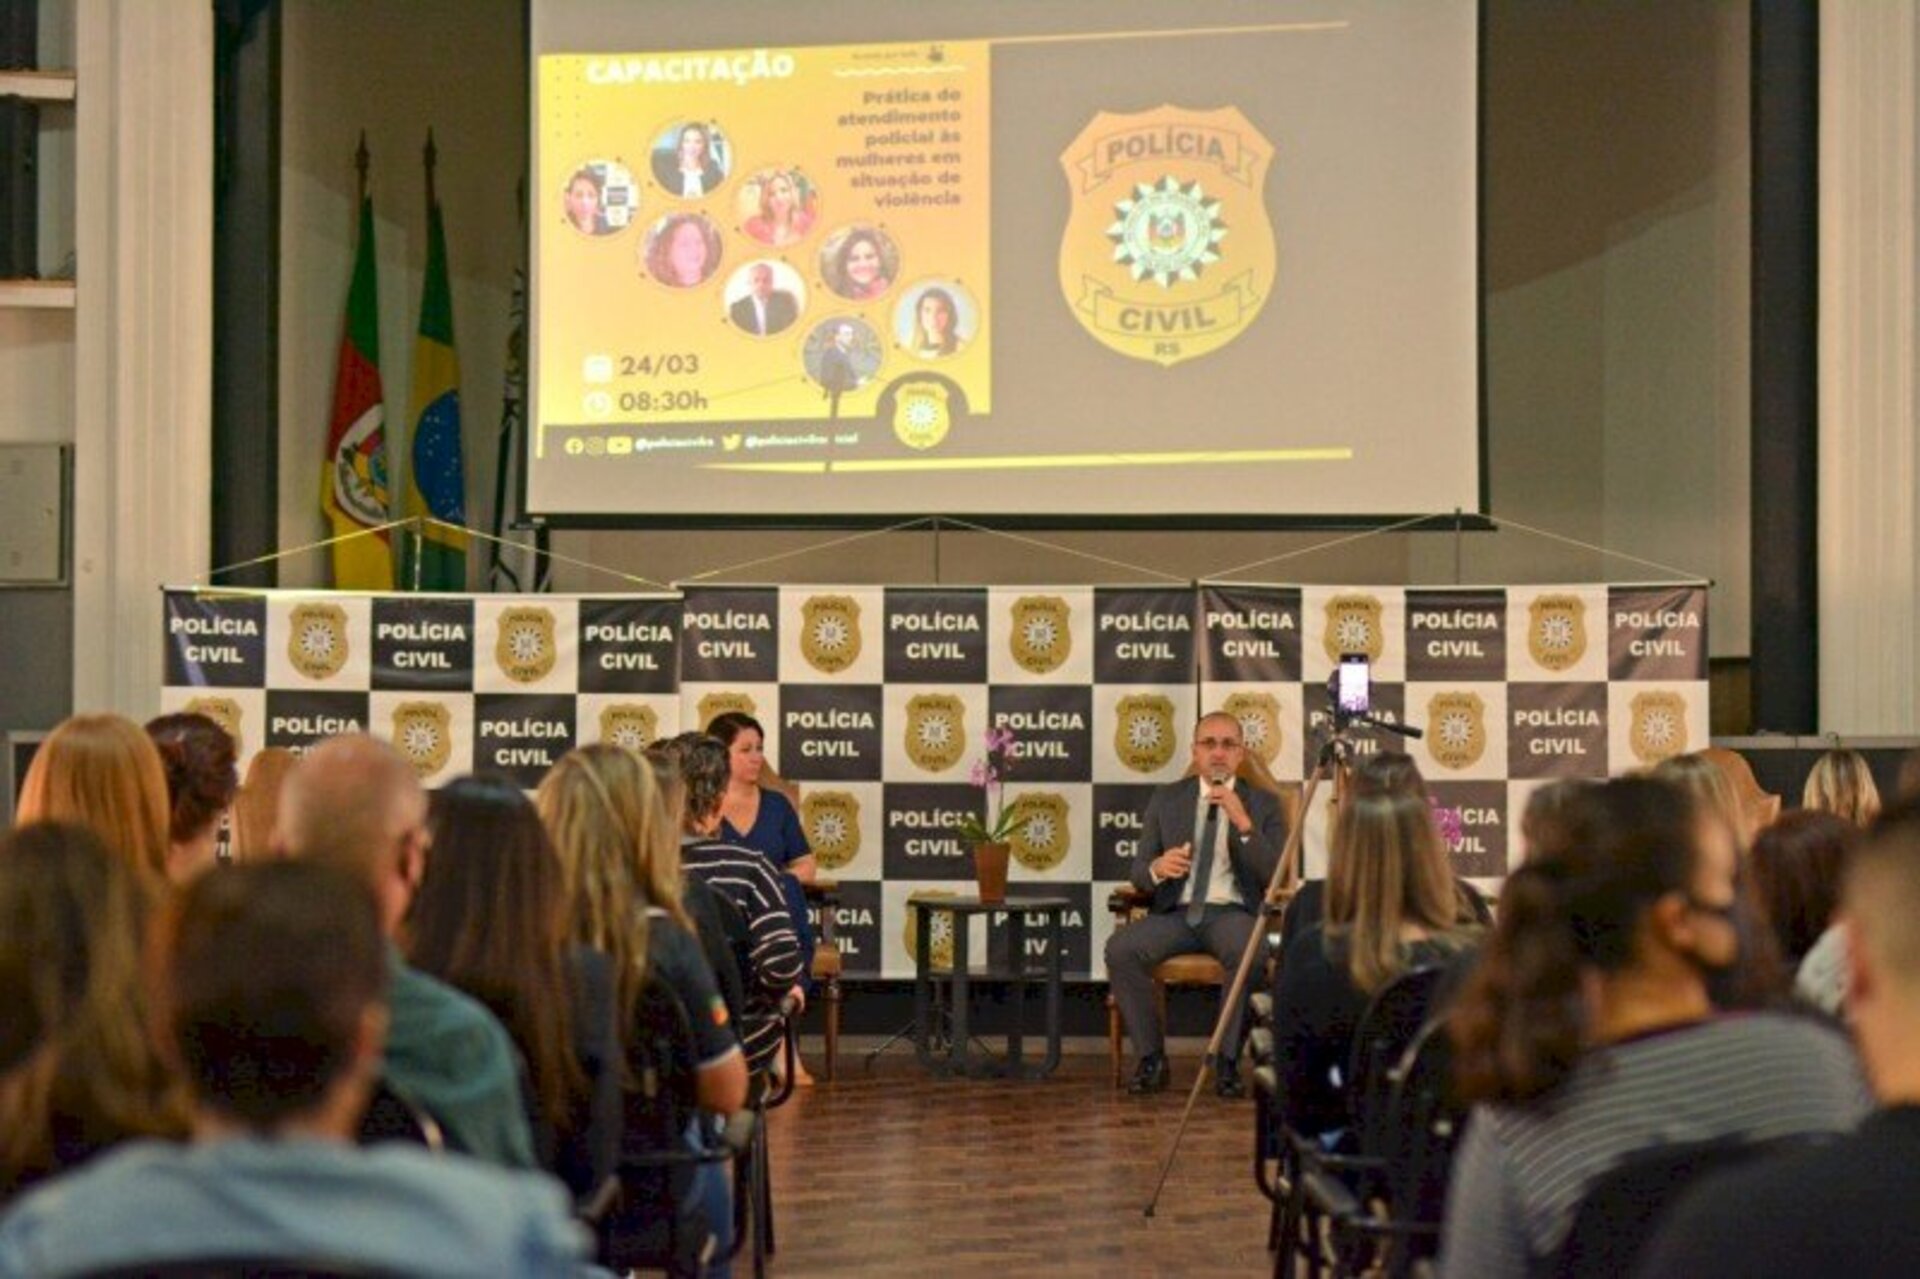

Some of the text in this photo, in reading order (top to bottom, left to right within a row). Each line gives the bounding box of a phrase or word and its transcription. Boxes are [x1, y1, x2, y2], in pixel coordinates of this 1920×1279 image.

[586, 50, 796, 86] CAPACITAÇÃO
[863, 88, 931, 105] Prática
[838, 109, 961, 126] atendimento
[865, 130, 933, 148] policial
[1108, 126, 1225, 163] POLÍCIA
[836, 152, 961, 168] mulheres em
[851, 170, 961, 188] situação de
[874, 190, 961, 208] violência
[1119, 306, 1216, 332] CIVIL
[1154, 342, 1180, 355] RS
[619, 354, 699, 377] 24/03
[619, 390, 708, 412] 08:30h
[170, 616, 258, 636] POLÍCIA
[683, 610, 771, 630] POLÍCIA
[891, 611, 980, 631] POLÍCIA
[1101, 611, 1190, 631] POLÍCIA
[1207, 609, 1294, 629] POLÍCIA
[1412, 609, 1498, 629] POLÍCIA
[1615, 610, 1700, 628] POLÍCIA
[378, 622, 466, 641] POLÍCIA
[585, 624, 673, 642] POLÍCIA
[185, 647, 243, 663] CIVIL
[698, 642, 756, 659] CIVIL
[906, 643, 965, 659] CIVIL
[1116, 643, 1175, 659] CIVIL
[1223, 641, 1280, 657] CIVIL
[1427, 640, 1484, 657] CIVIL
[1629, 640, 1685, 656] CIVIL
[393, 651, 451, 668] CIVIL
[601, 653, 658, 670] CIVIL
[272, 714, 360, 734] POLÍCIA
[786, 709, 874, 728] POLÍCIA
[995, 710, 1084, 729] POLÍCIA
[1514, 708, 1600, 726] POLÍCIA
[481, 718, 568, 738] POLÍCIA
[801, 741, 859, 757] CIVIL
[1010, 741, 1069, 758] CIVIL
[1530, 738, 1586, 754] CIVIL
[495, 749, 553, 766] CIVIL
[904, 839, 964, 856] CIVIL
